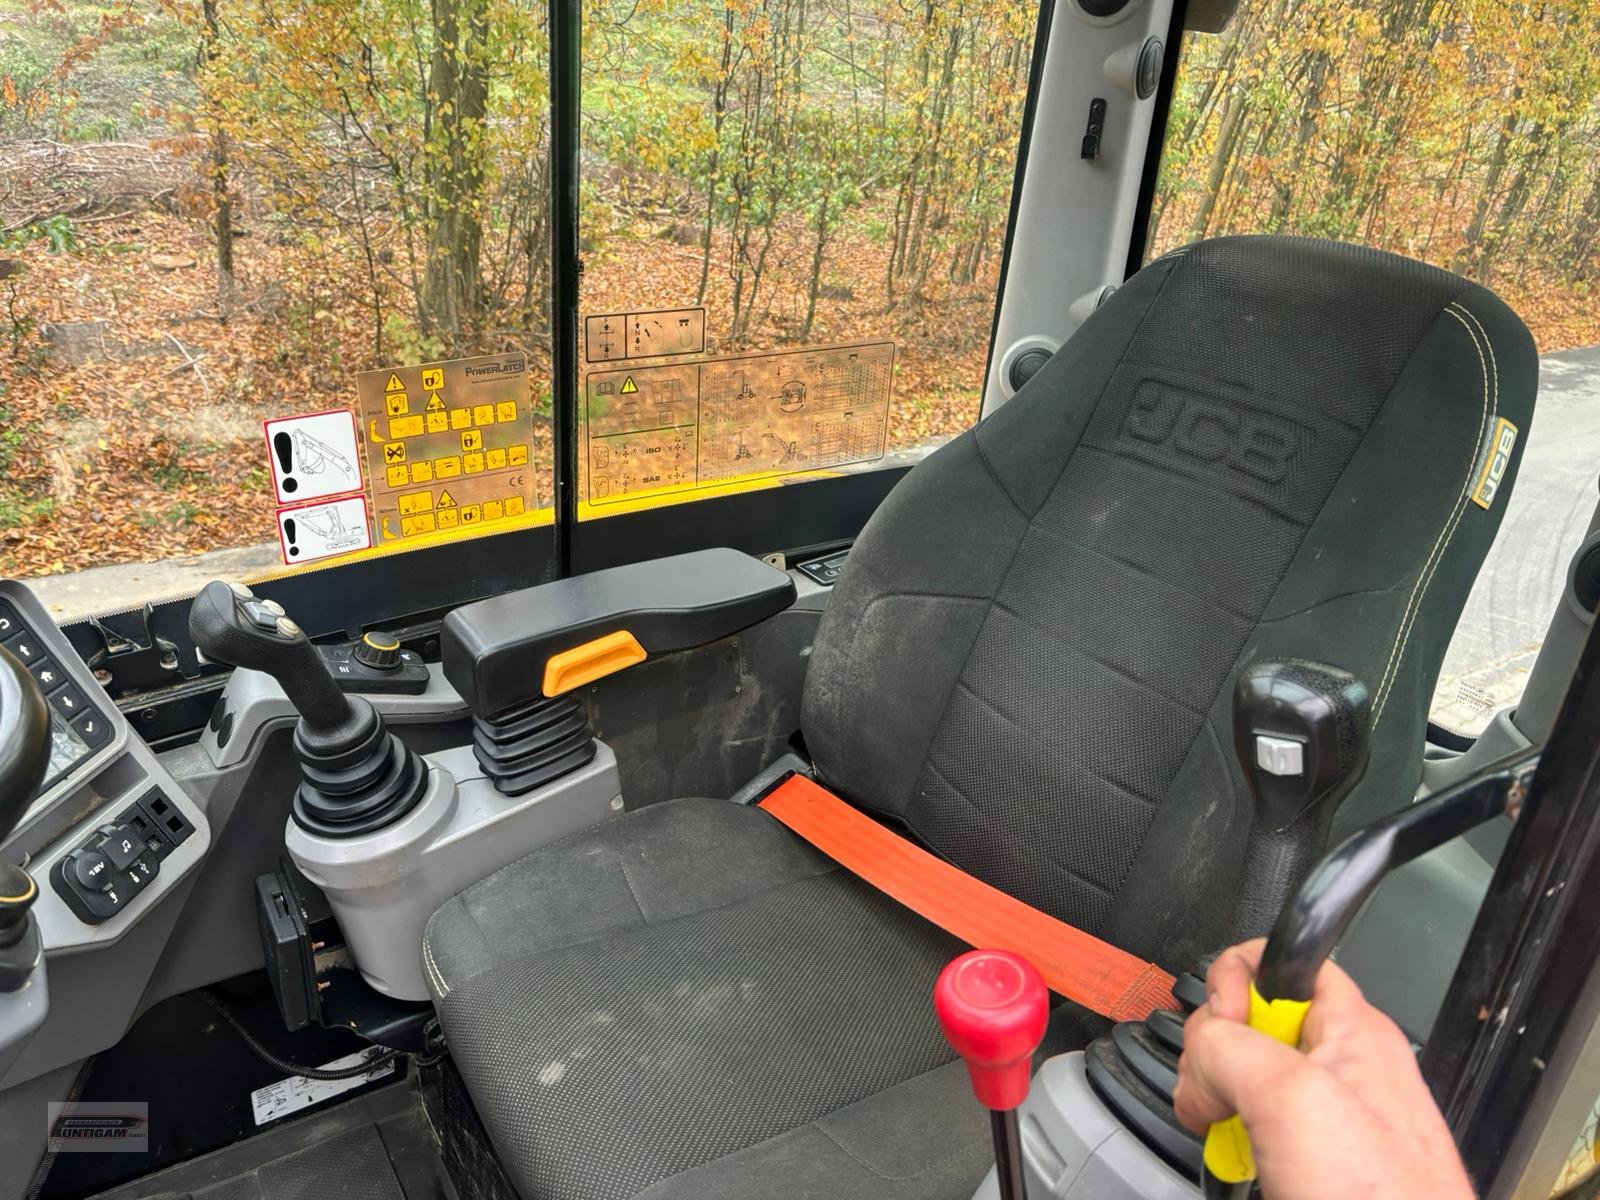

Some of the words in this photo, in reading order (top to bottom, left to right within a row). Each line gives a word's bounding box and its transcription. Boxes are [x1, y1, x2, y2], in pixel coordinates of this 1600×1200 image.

[645, 446, 661, 454] ISO
[1122, 380, 1302, 486] JCB
[642, 475, 661, 484] SAE
[1480, 428, 1515, 502] JCB
